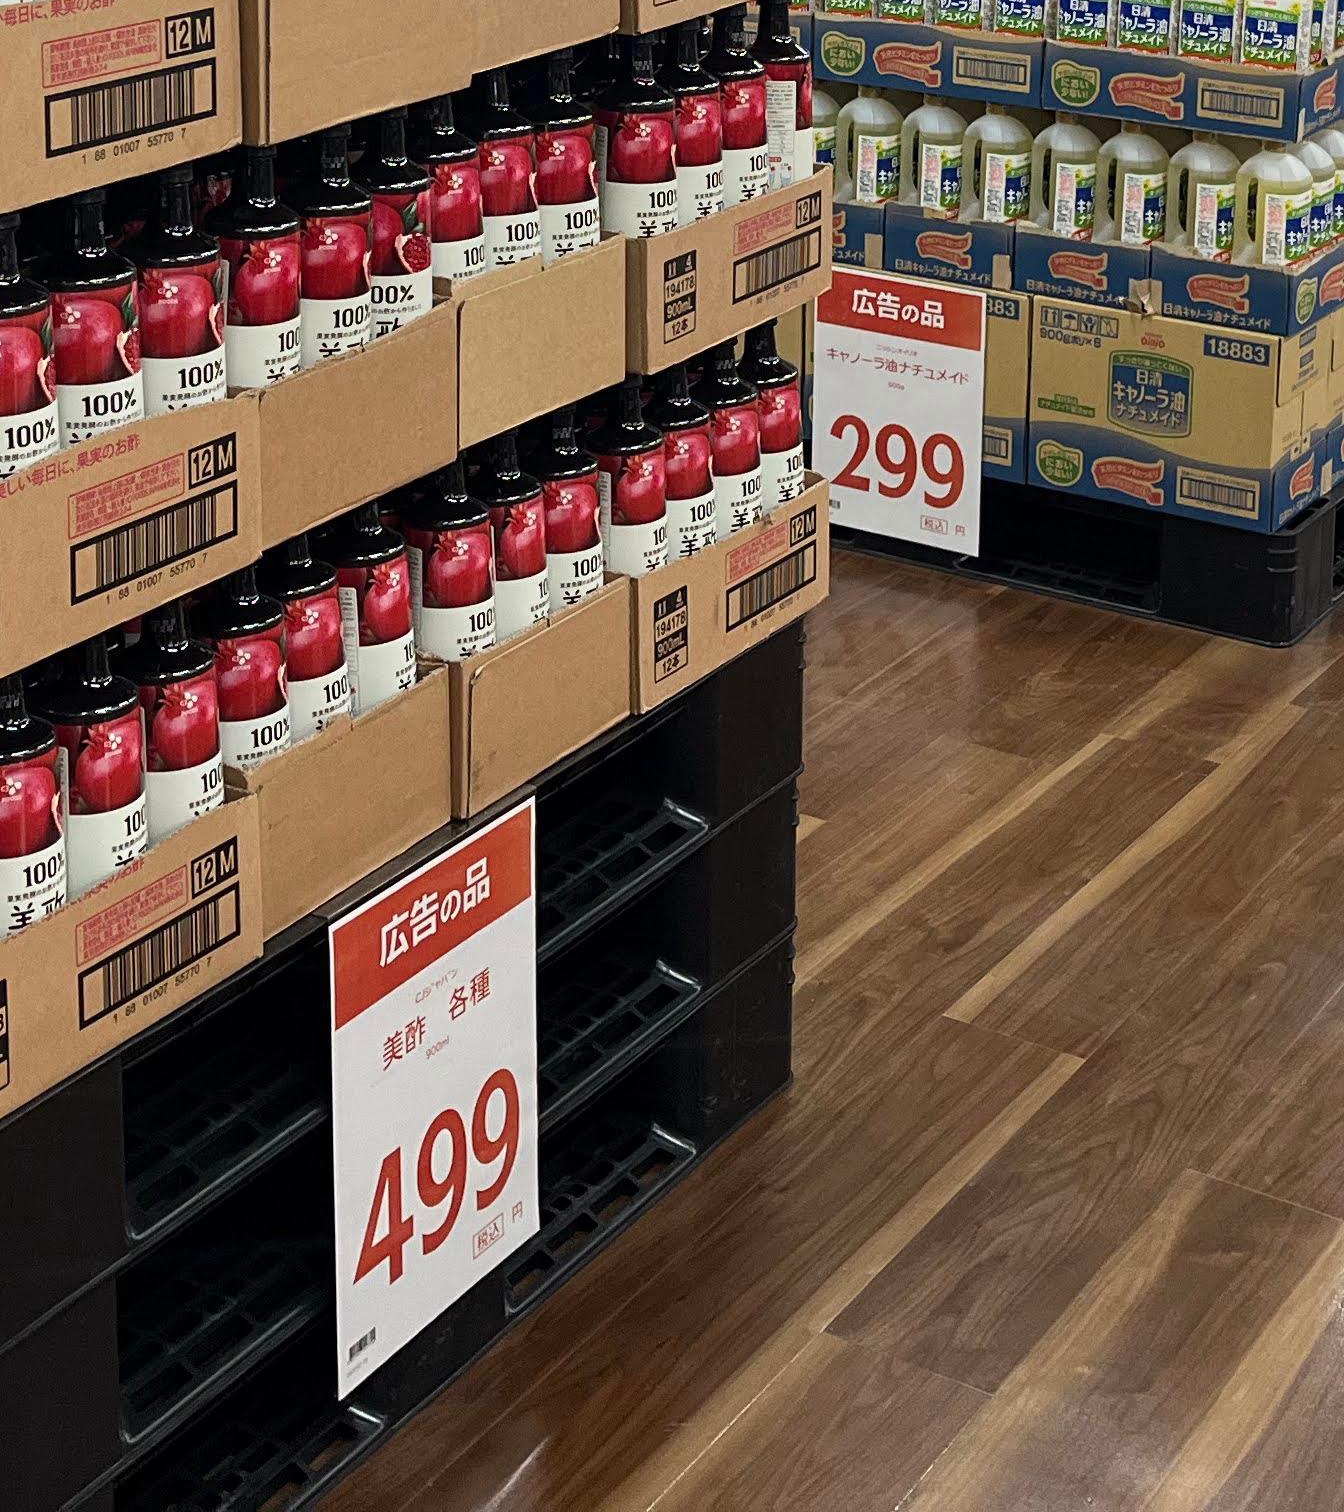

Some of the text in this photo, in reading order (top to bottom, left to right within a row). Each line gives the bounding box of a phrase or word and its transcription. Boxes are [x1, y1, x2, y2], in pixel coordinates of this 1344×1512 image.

[1070, 0, 1088, 11] 日清
[1132, 5, 1151, 17] 日清
[1193, 13, 1213, 24] 日清
[170, 16, 211, 52] 12 M
[1257, 20, 1277, 32] 日清
[114, 140, 140, 157] 01007
[853, 289, 945, 329] 広告の品
[826, 347, 969, 385] キャノーラ油ナチュメイド
[1207, 338, 1265, 362] 18883
[1136, 369, 1162, 386] 日清
[1113, 381, 1186, 412] キャノーラ油
[1117, 404, 1184, 427] ナチュメイド
[5, 419, 55, 447] 100%
[193, 444, 233, 485] 12 M
[830, 414, 964, 509] 299
[924, 519, 965, 536] 税込 円
[196, 845, 234, 896] 12 M
[379, 858, 491, 968] 広告の品
[448, 968, 491, 1022] 各種
[383, 1016, 426, 1069] 美酢
[354, 1068, 520, 1287] 499
[478, 1201, 523, 1250] 税込 円
